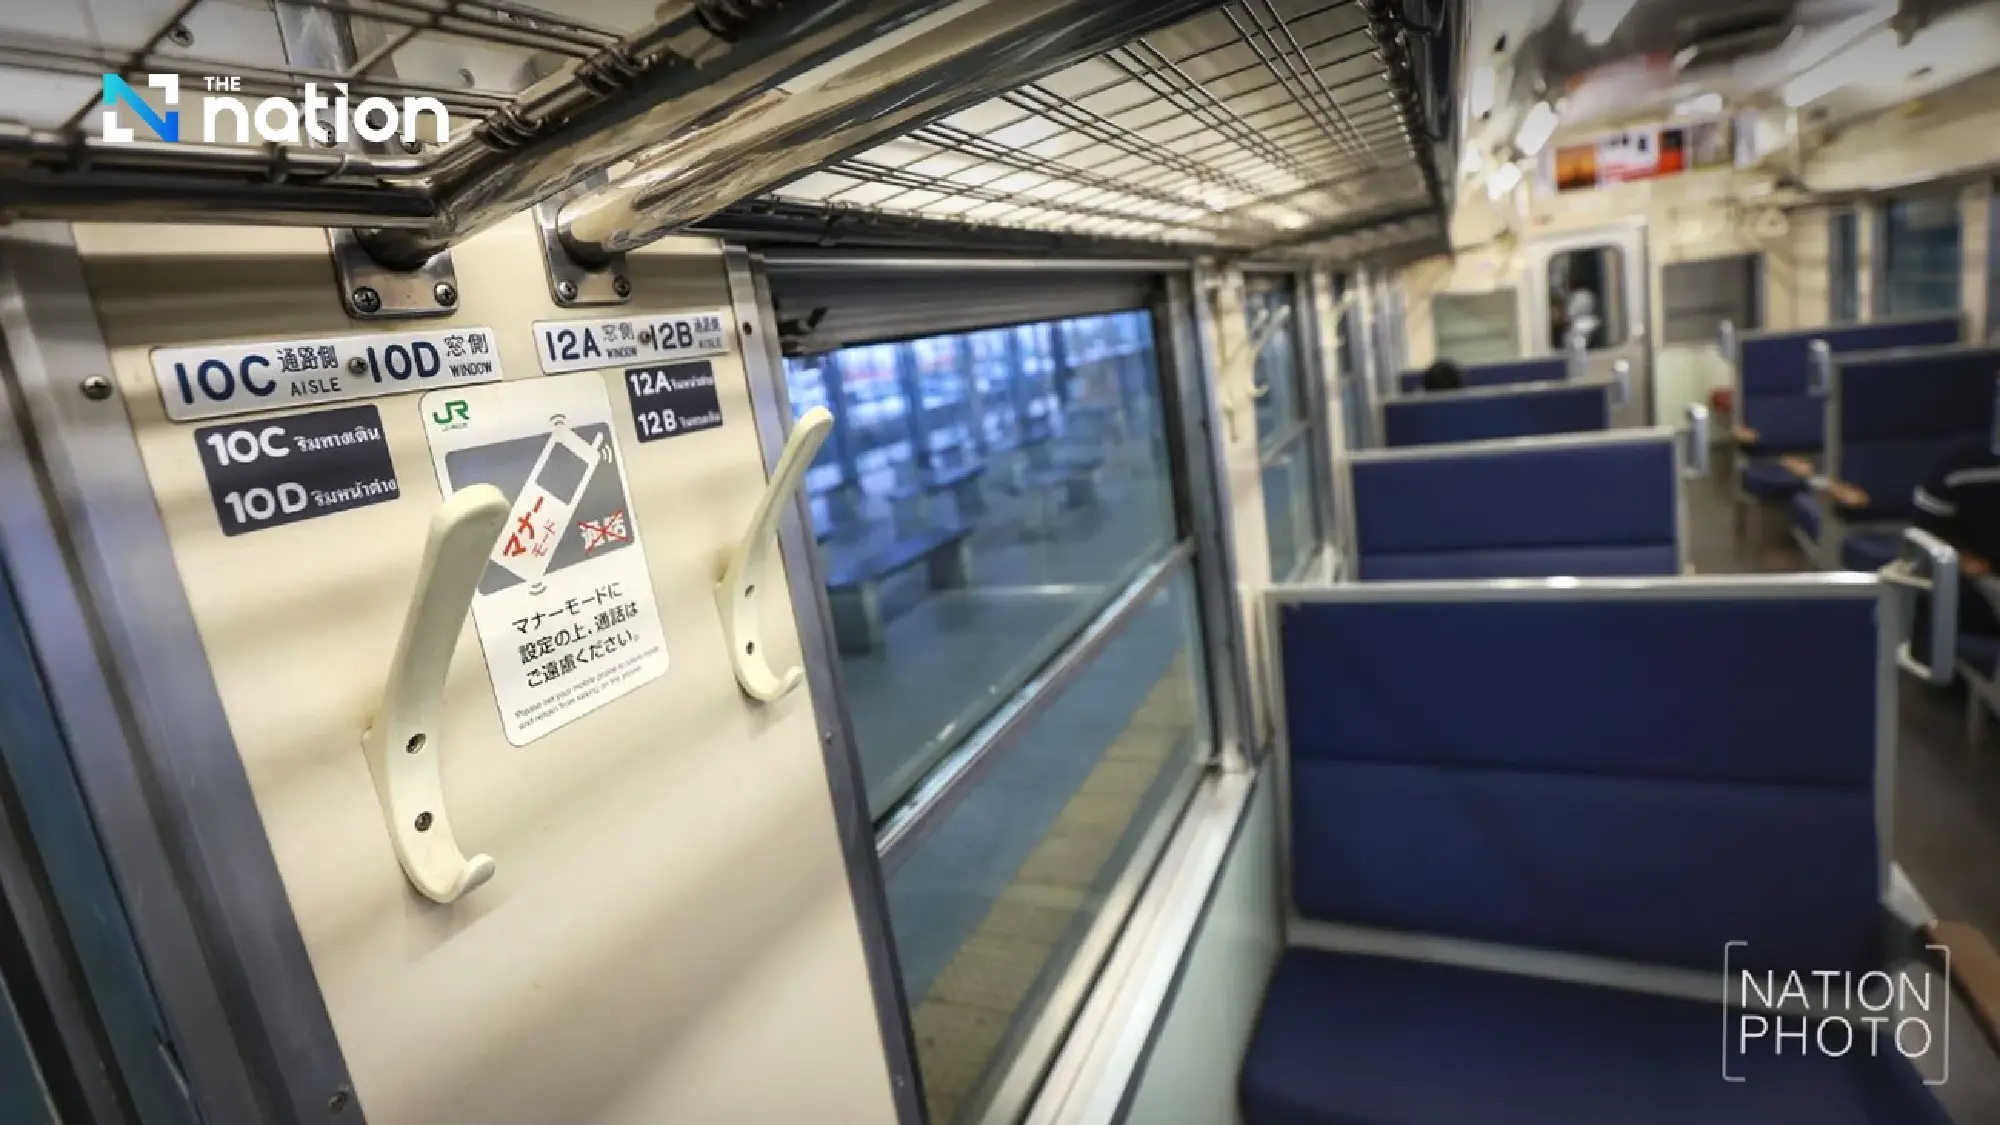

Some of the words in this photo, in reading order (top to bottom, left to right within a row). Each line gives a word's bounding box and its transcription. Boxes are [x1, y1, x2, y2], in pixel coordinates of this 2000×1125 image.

[545, 327, 602, 362] 12A
[649, 321, 693, 352] 12B
[174, 354, 276, 405] 10C
[277, 345, 339, 373] 通路側
[366, 341, 441, 383] 10D
[291, 376, 342, 397] AISLE
[449, 360, 492, 377] WINDOW
[629, 370, 672, 397] 12A
[432, 400, 470, 424] JR
[638, 408, 677, 436] 12B
[206, 425, 290, 466] 10C
[224, 482, 308, 524] 10D
[502, 496, 544, 557] マナー
[512, 582, 622, 634] マナーモードに
